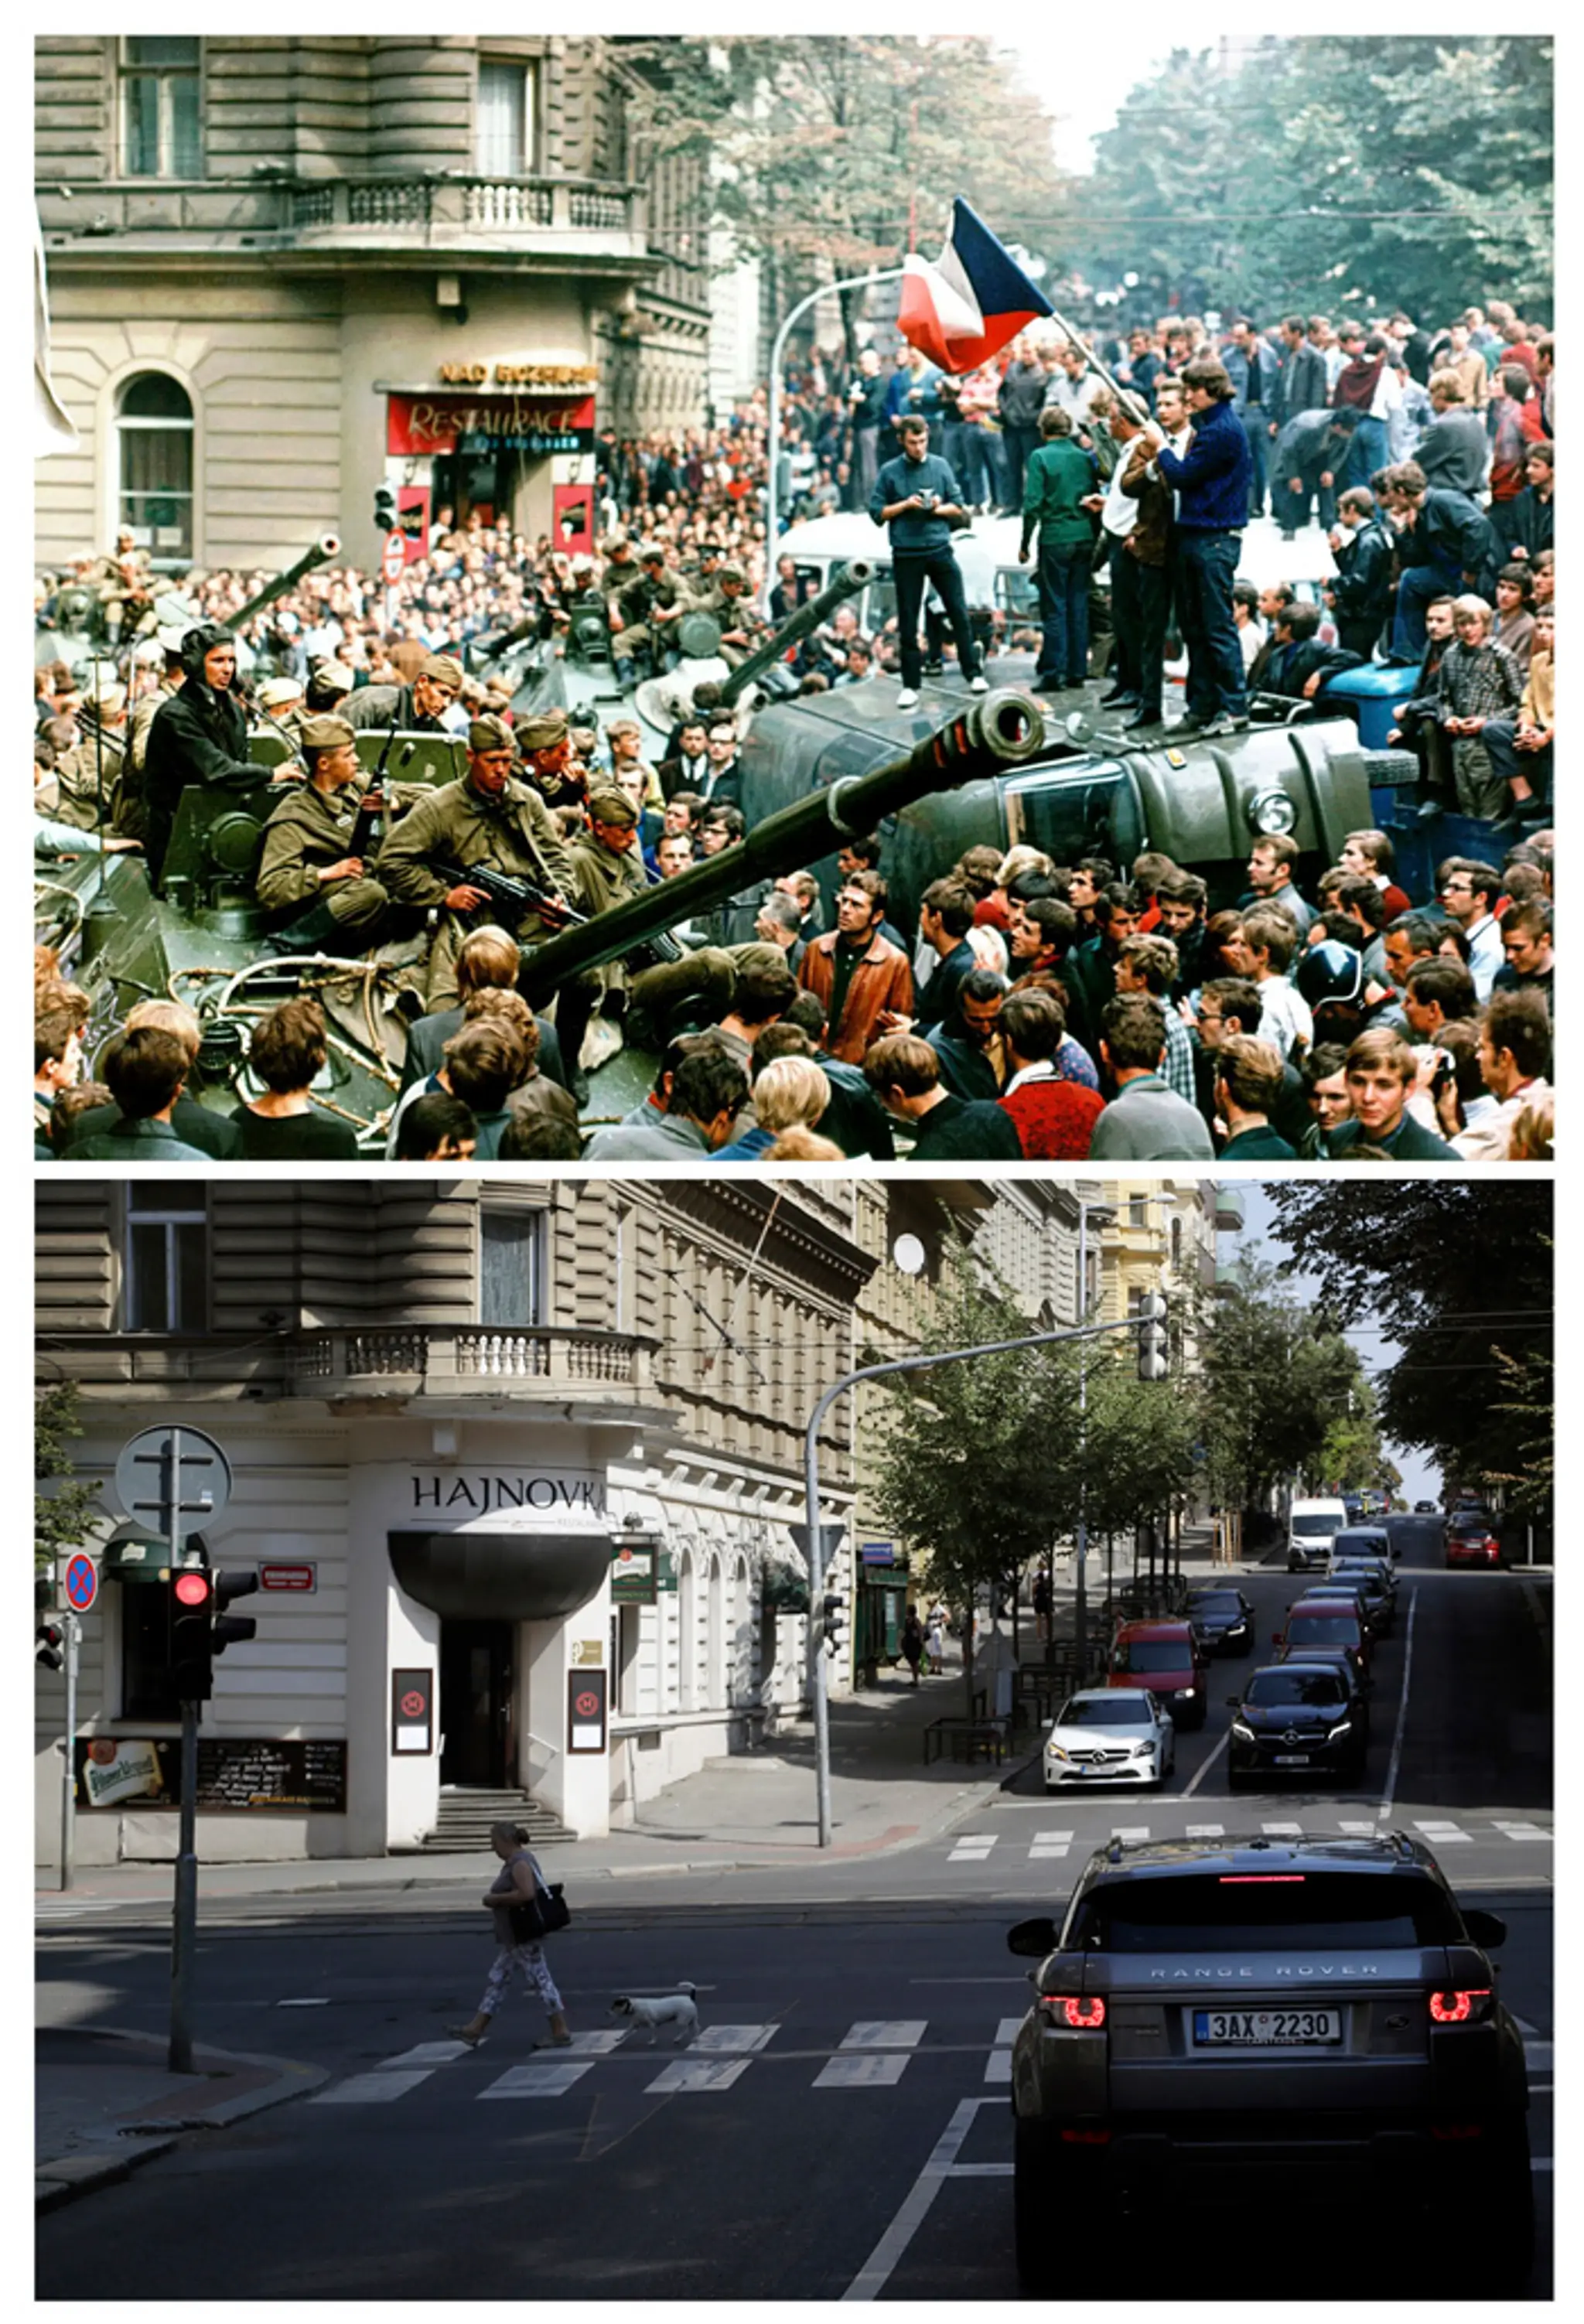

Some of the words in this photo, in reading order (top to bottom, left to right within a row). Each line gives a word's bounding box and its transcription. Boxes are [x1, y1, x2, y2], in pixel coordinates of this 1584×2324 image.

[1151, 1966, 1253, 1978] RANGE
[1275, 1964, 1377, 1976] ROVER
[1212, 2013, 1255, 2039] 3AX
[1272, 2013, 1330, 2038] 2230
